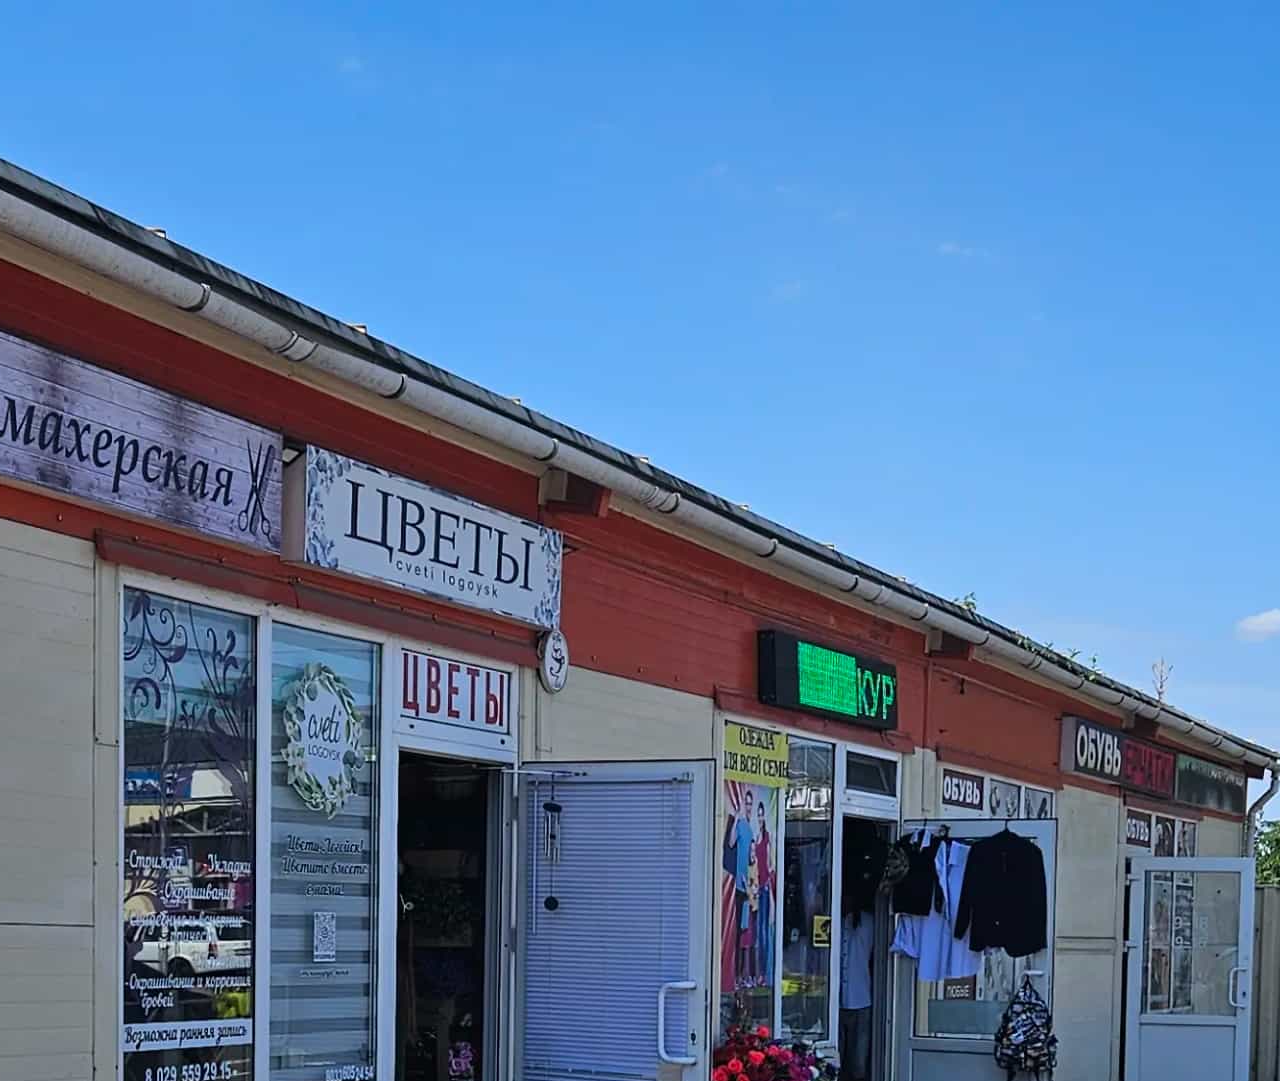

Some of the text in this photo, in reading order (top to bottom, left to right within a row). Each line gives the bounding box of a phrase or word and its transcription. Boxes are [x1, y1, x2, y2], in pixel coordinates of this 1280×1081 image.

[344, 478, 535, 592] ЦВЕТЫ
[396, 558, 499, 599] cveti logoysk
[402, 652, 505, 727] ЦВЕТЫ
[739, 727, 775, 752] ОДЕЖДА
[1077, 725, 1122, 776] ОБУВЬ
[740, 754, 761, 777] ВСЕЙ
[943, 776, 980, 805] ОБУВЬ
[124, 1025, 248, 1050] Возможна ранняя запись
[203, 1062, 217, 1081] 29
